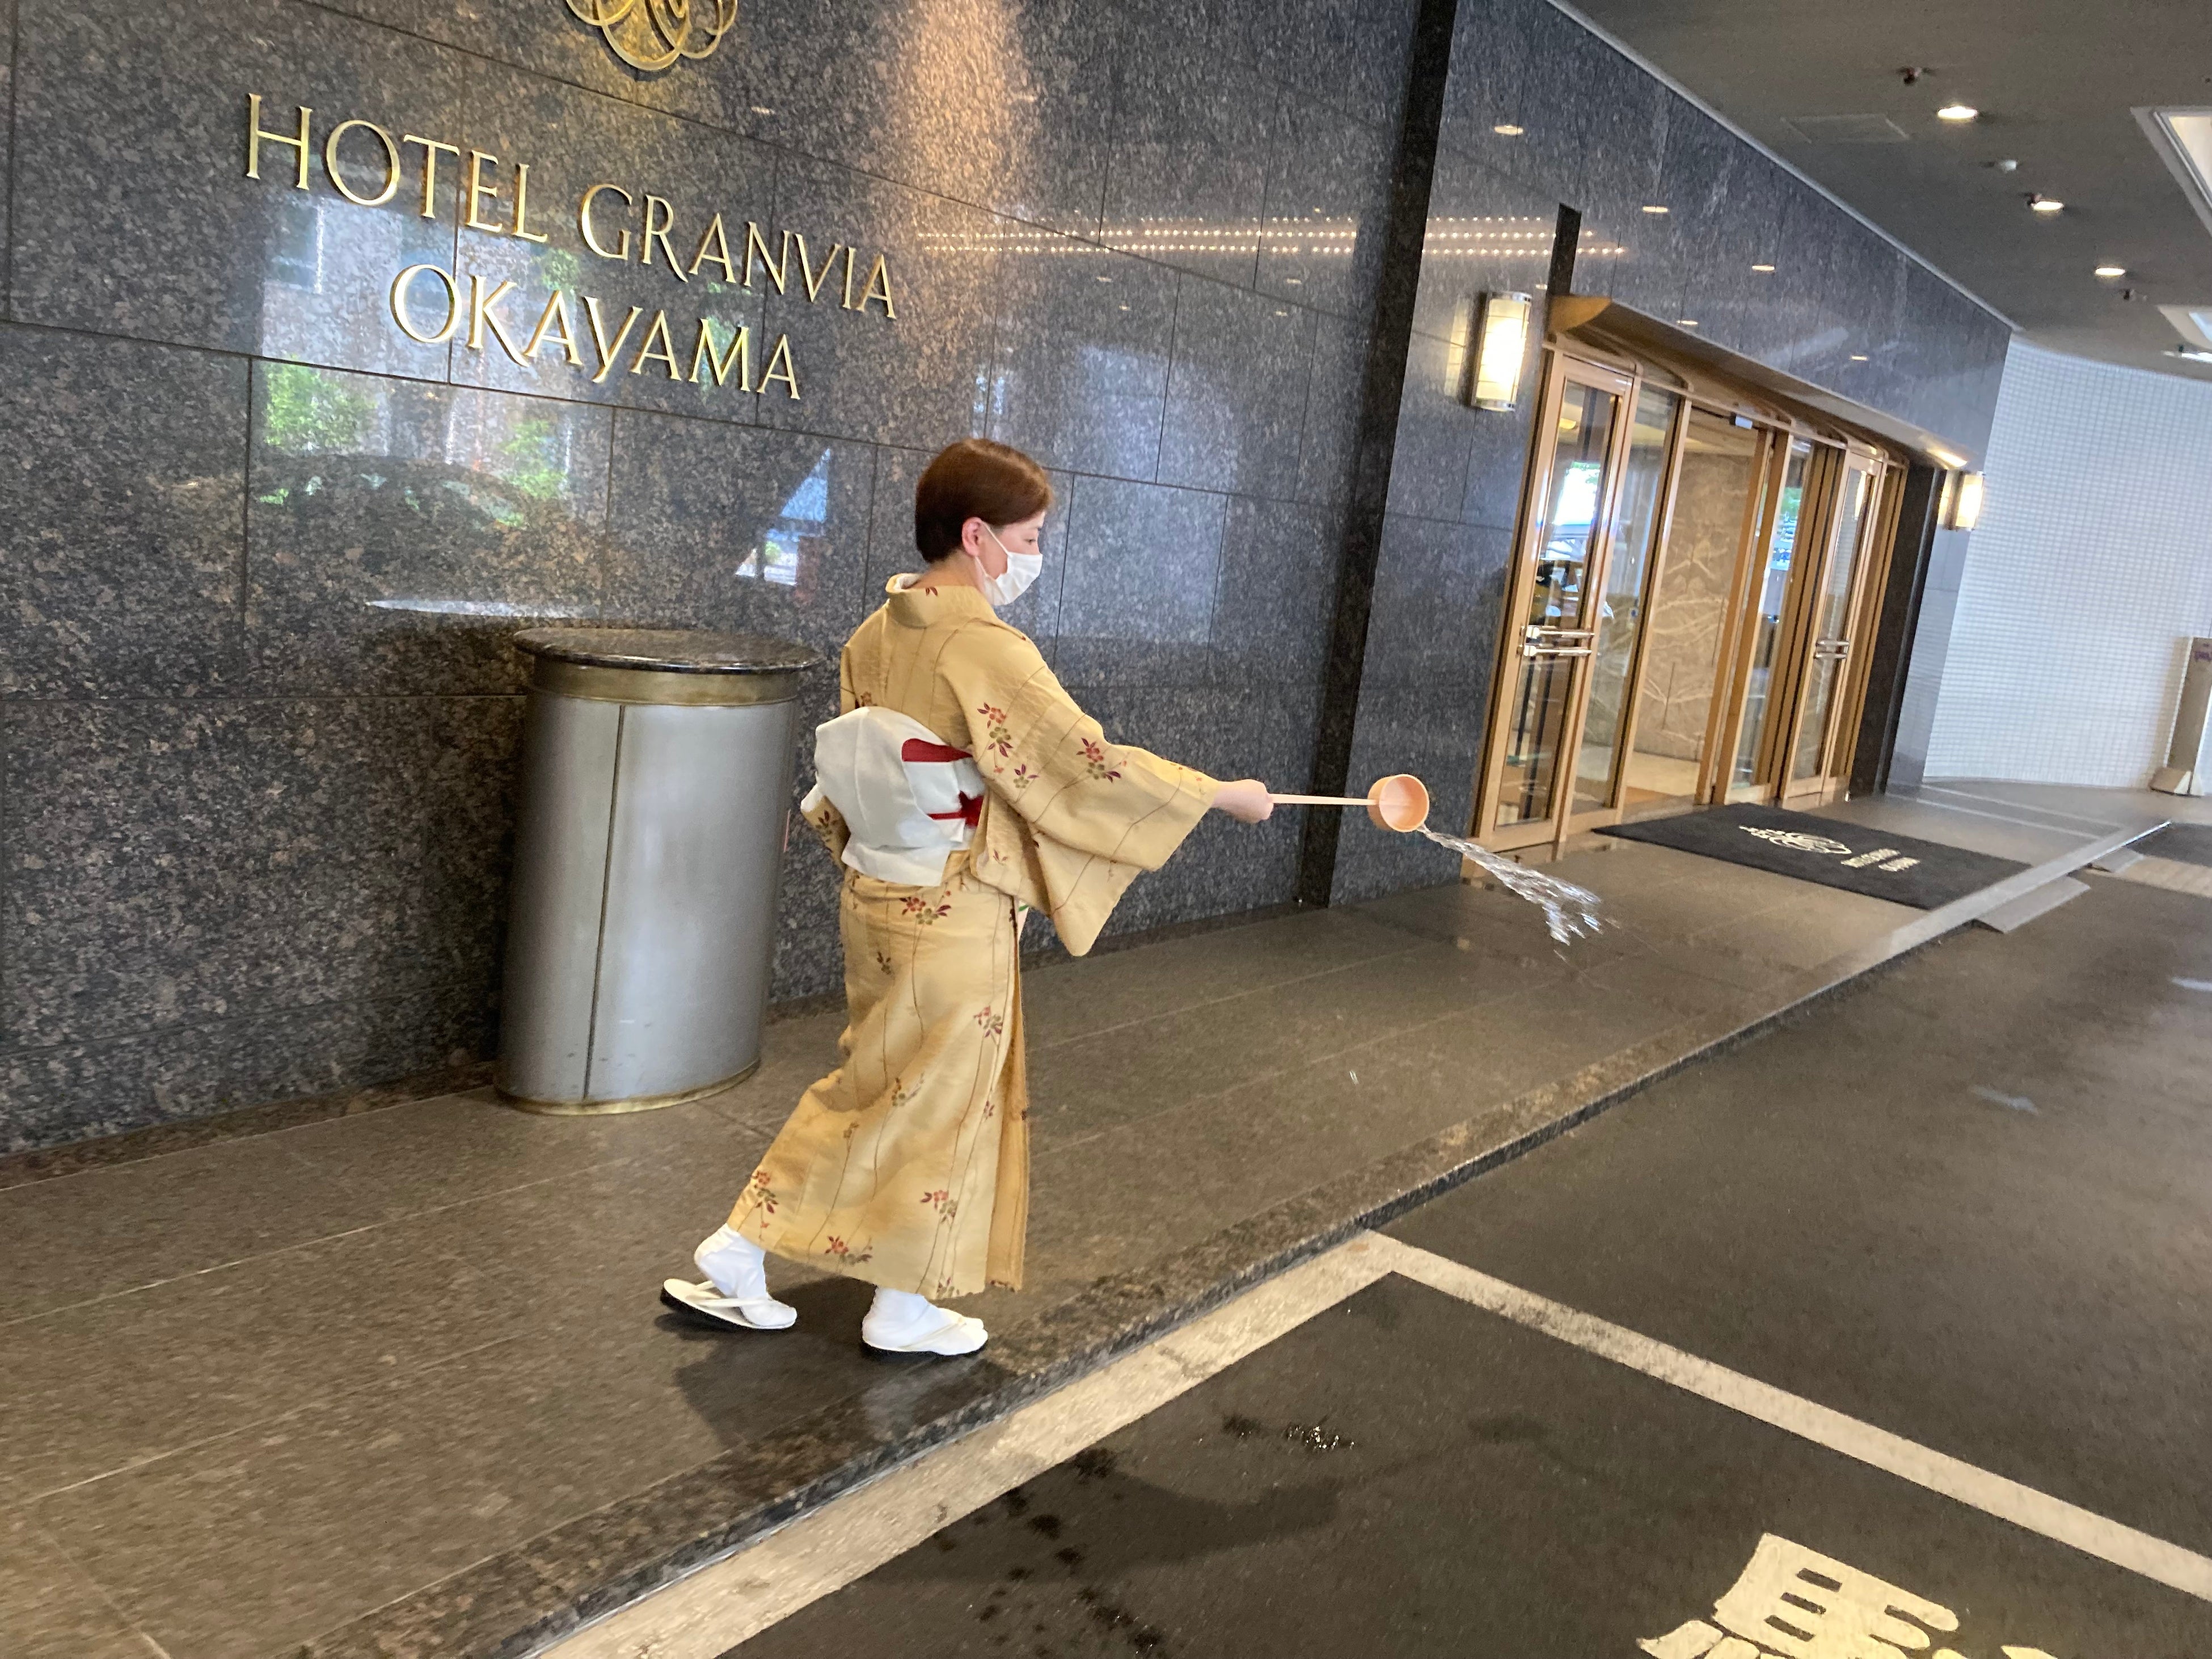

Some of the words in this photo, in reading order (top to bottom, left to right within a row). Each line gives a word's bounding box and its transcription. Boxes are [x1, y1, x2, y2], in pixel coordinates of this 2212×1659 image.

[246, 93, 547, 243] HOTEL
[580, 184, 897, 319] GRANVIA
[391, 264, 801, 400] OKAYAMA
